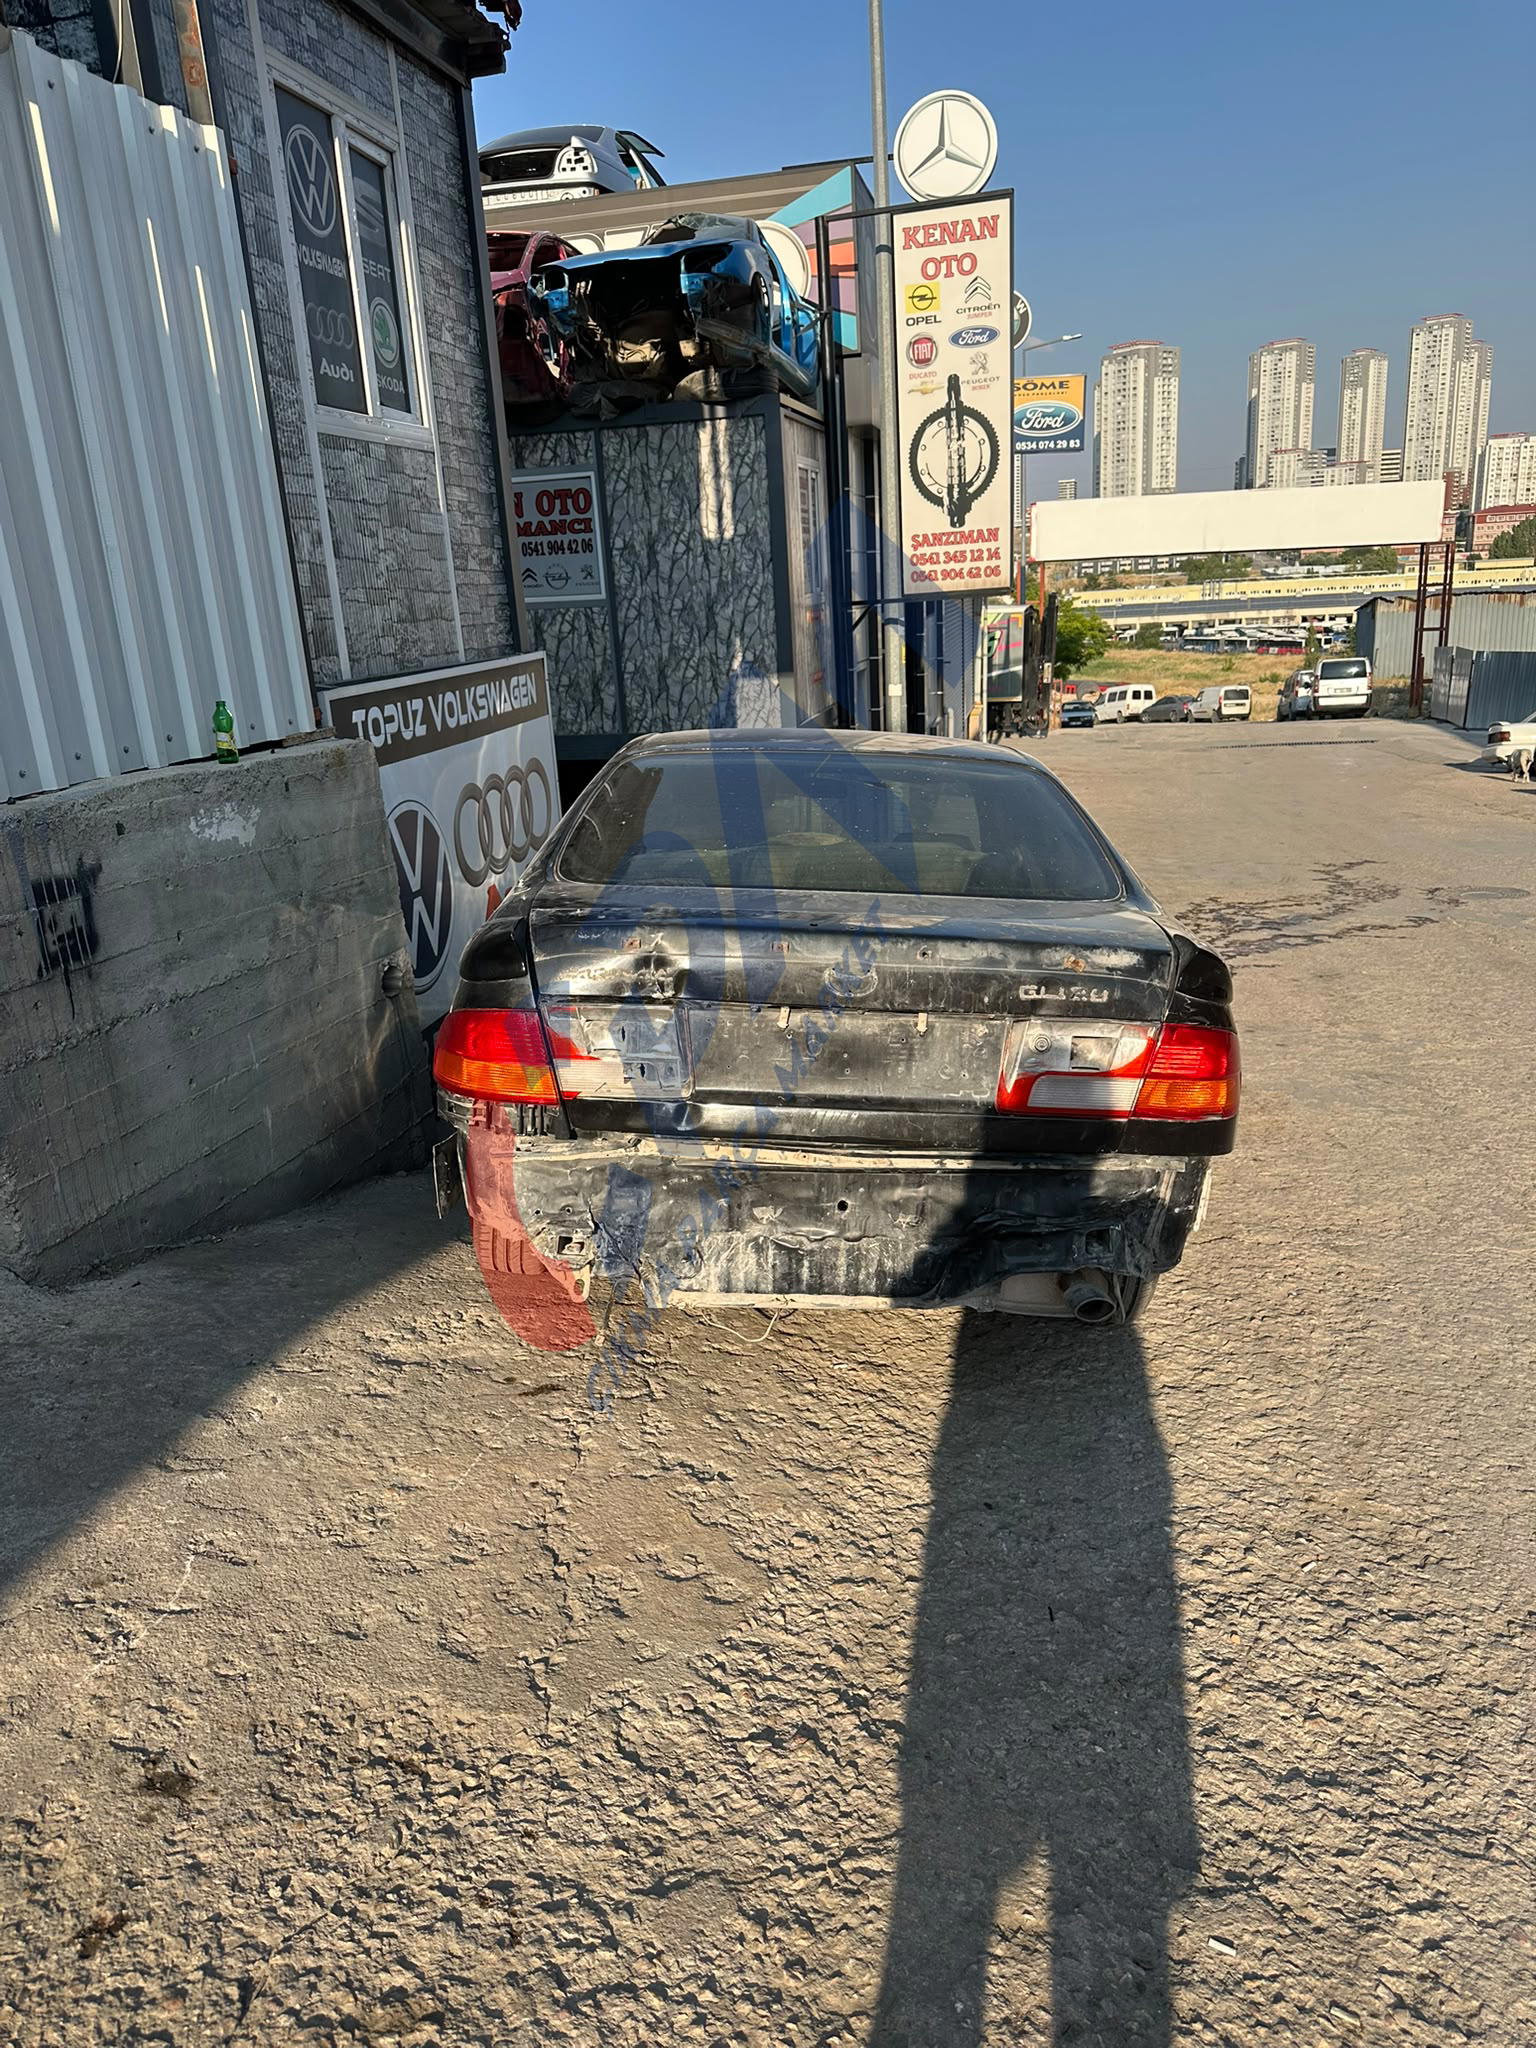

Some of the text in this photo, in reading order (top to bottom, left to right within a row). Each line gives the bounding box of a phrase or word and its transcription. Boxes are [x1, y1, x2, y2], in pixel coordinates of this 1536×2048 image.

[902, 215, 1000, 250] KENAN
[297, 243, 347, 281] VOLKSWAGEN
[362, 257, 391, 282] SEAT
[921, 253, 978, 281] OTO
[906, 315, 942, 327] OPEL
[958, 328, 990, 345] Ford
[914, 343, 931, 359] FIAT
[319, 358, 354, 383] Audi
[908, 371, 937, 380] DUCATO
[961, 376, 1000, 385] PEUGEOT
[1022, 408, 1065, 429] Ford
[1015, 441, 1037, 451] 0534
[1039, 440, 1055, 450] 074
[1056, 440, 1068, 449] 29
[535, 488, 592, 517] OTO
[522, 537, 594, 557] 0541 904 42 06
[911, 528, 1000, 551] ŞANZIMAN
[910, 551, 941, 567] 0541
[943, 549, 968, 565] 345
[969, 548, 984, 562] 12
[910, 565, 1002, 583] 0541 904 42 06
[352, 672, 538, 748] TOPUZ VOLKSWAGEN
